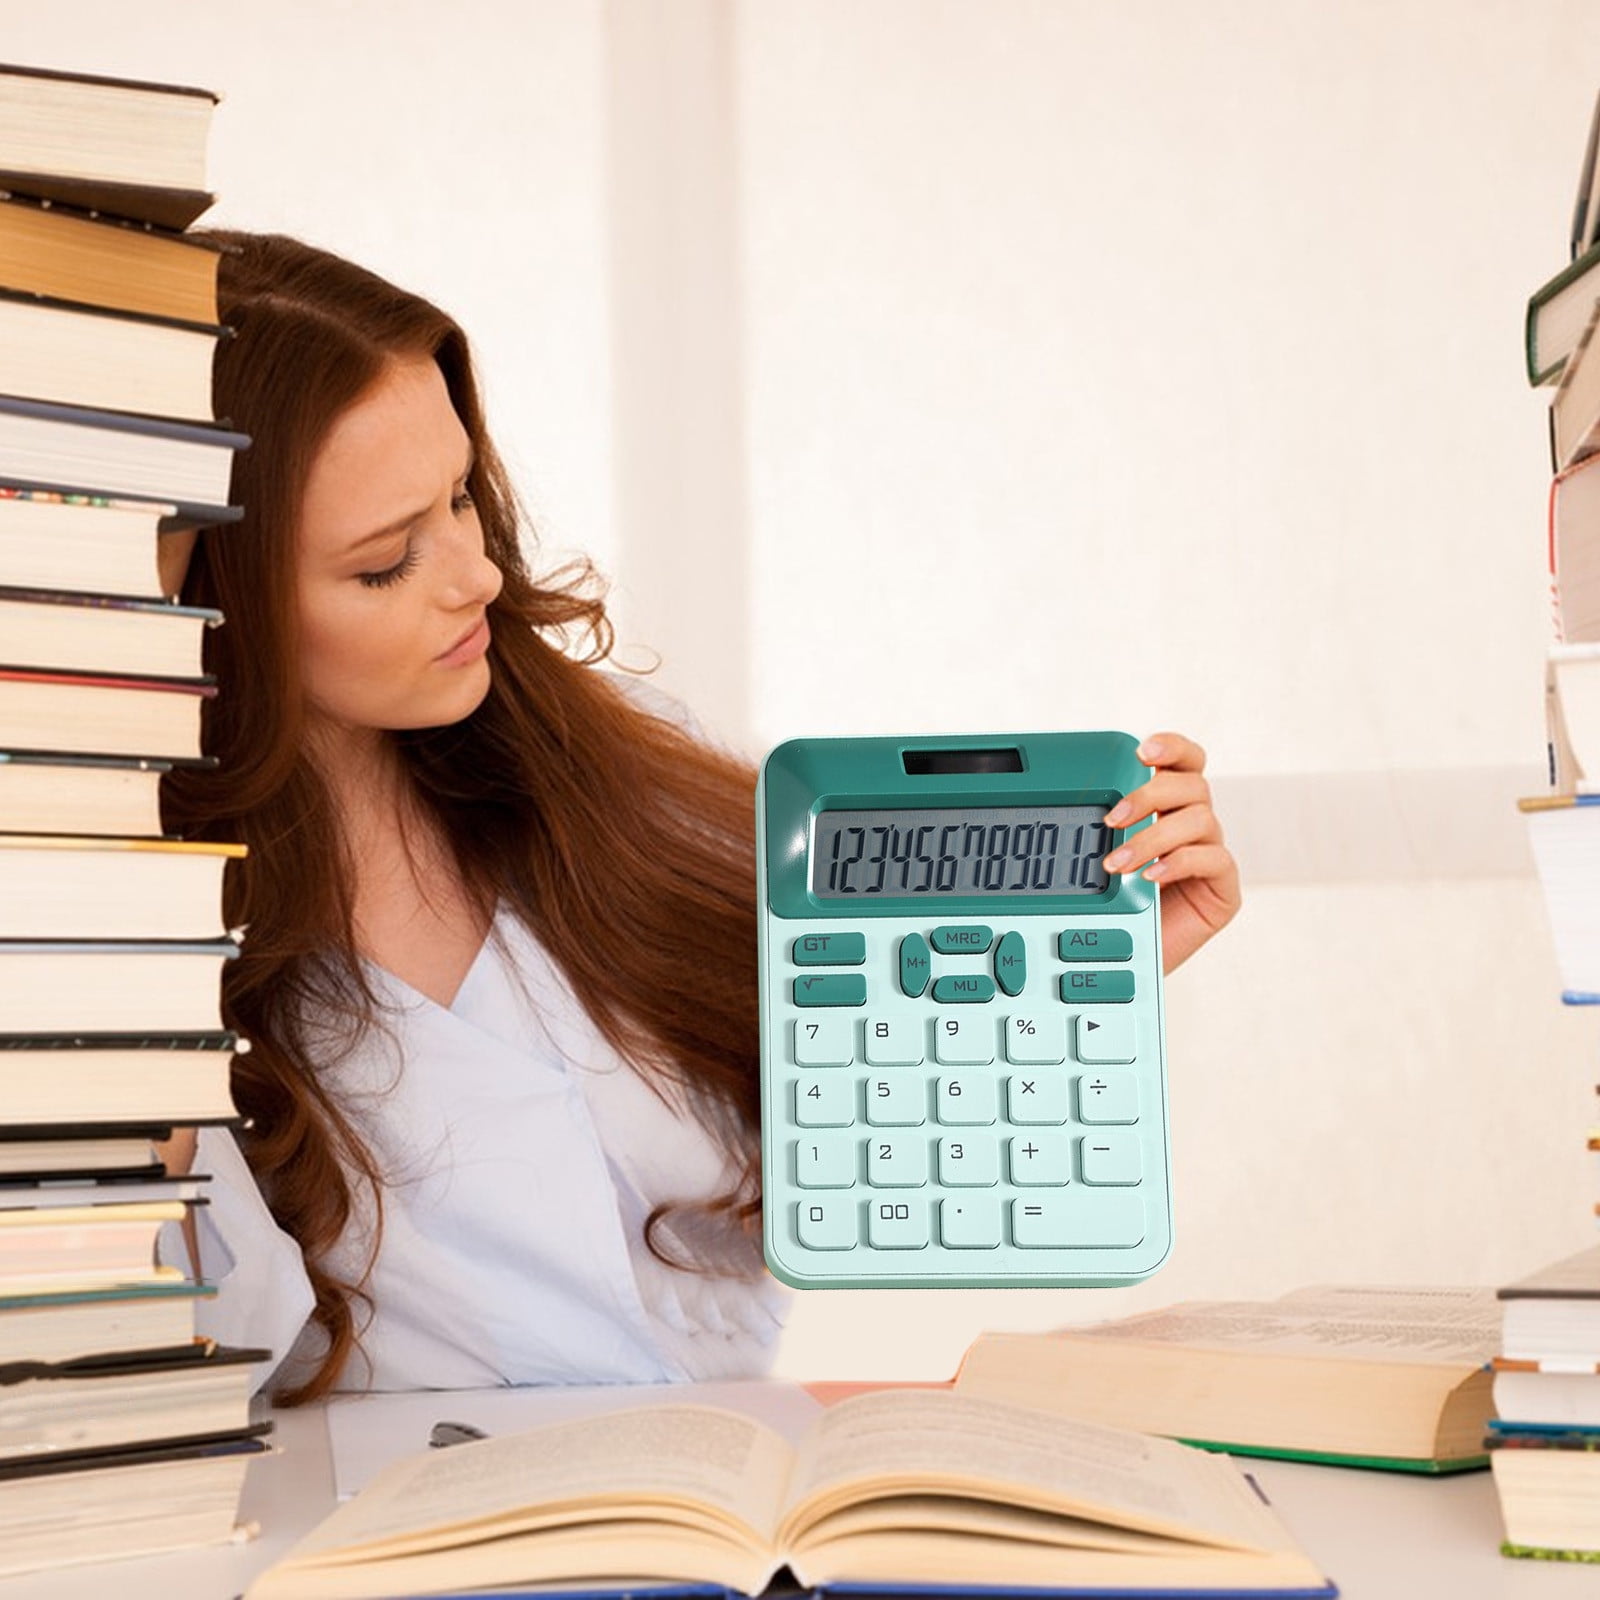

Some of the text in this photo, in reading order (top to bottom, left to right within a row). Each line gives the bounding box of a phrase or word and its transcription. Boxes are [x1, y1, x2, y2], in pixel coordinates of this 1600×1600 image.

[804, 937, 831, 951] GT
[946, 932, 980, 944] MRC
[1070, 932, 1098, 946] AC
[907, 957, 927, 968] M+
[954, 980, 977, 991] MU
[1071, 973, 1097, 988] CE
[806, 1024, 819, 1039] 7
[875, 1022, 889, 1038] 8
[946, 1021, 959, 1036] 9
[1016, 1019, 1036, 1035] %
[807, 1085, 822, 1100] 4
[877, 1082, 890, 1097] 5
[948, 1081, 962, 1097] 6
[879, 1145, 892, 1160] 2
[950, 1144, 963, 1159] 3
[810, 1206, 823, 1222] 0
[880, 1204, 909, 1220] 00
